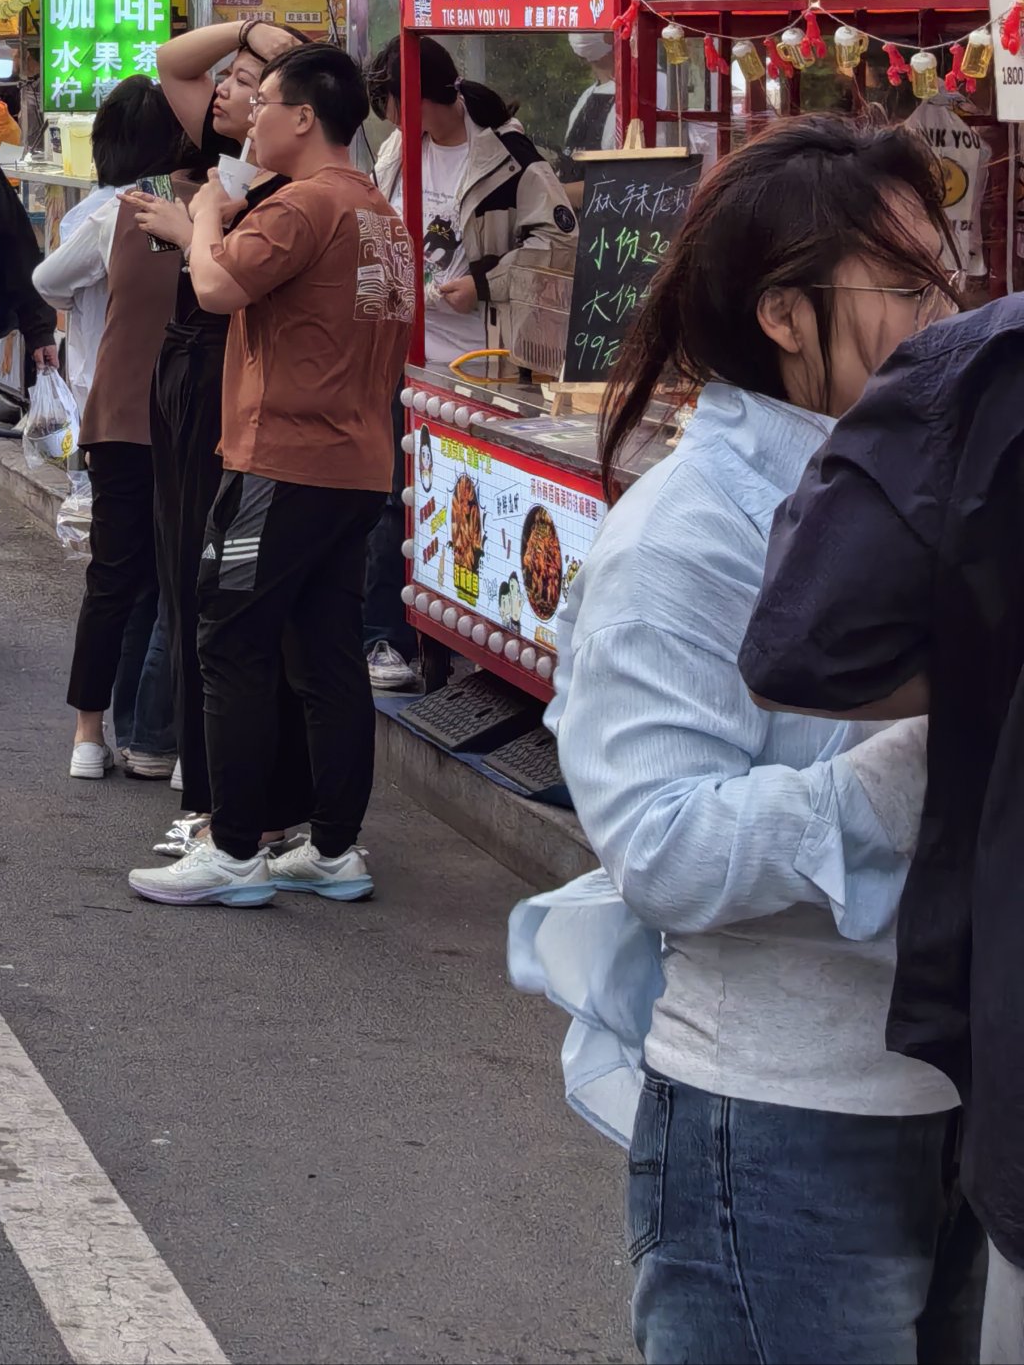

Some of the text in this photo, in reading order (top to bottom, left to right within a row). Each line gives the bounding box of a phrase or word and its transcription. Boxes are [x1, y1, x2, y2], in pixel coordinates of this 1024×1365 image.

[441, 8, 455, 25] TIE
[457, 8, 475, 26] BAN
[477, 8, 496, 26] YOU
[498, 8, 511, 26] YU
[51, 40, 161, 73] 水果茶
[951, 130, 981, 150] YOU
[584, 173, 695, 223] 麻辣龙虾
